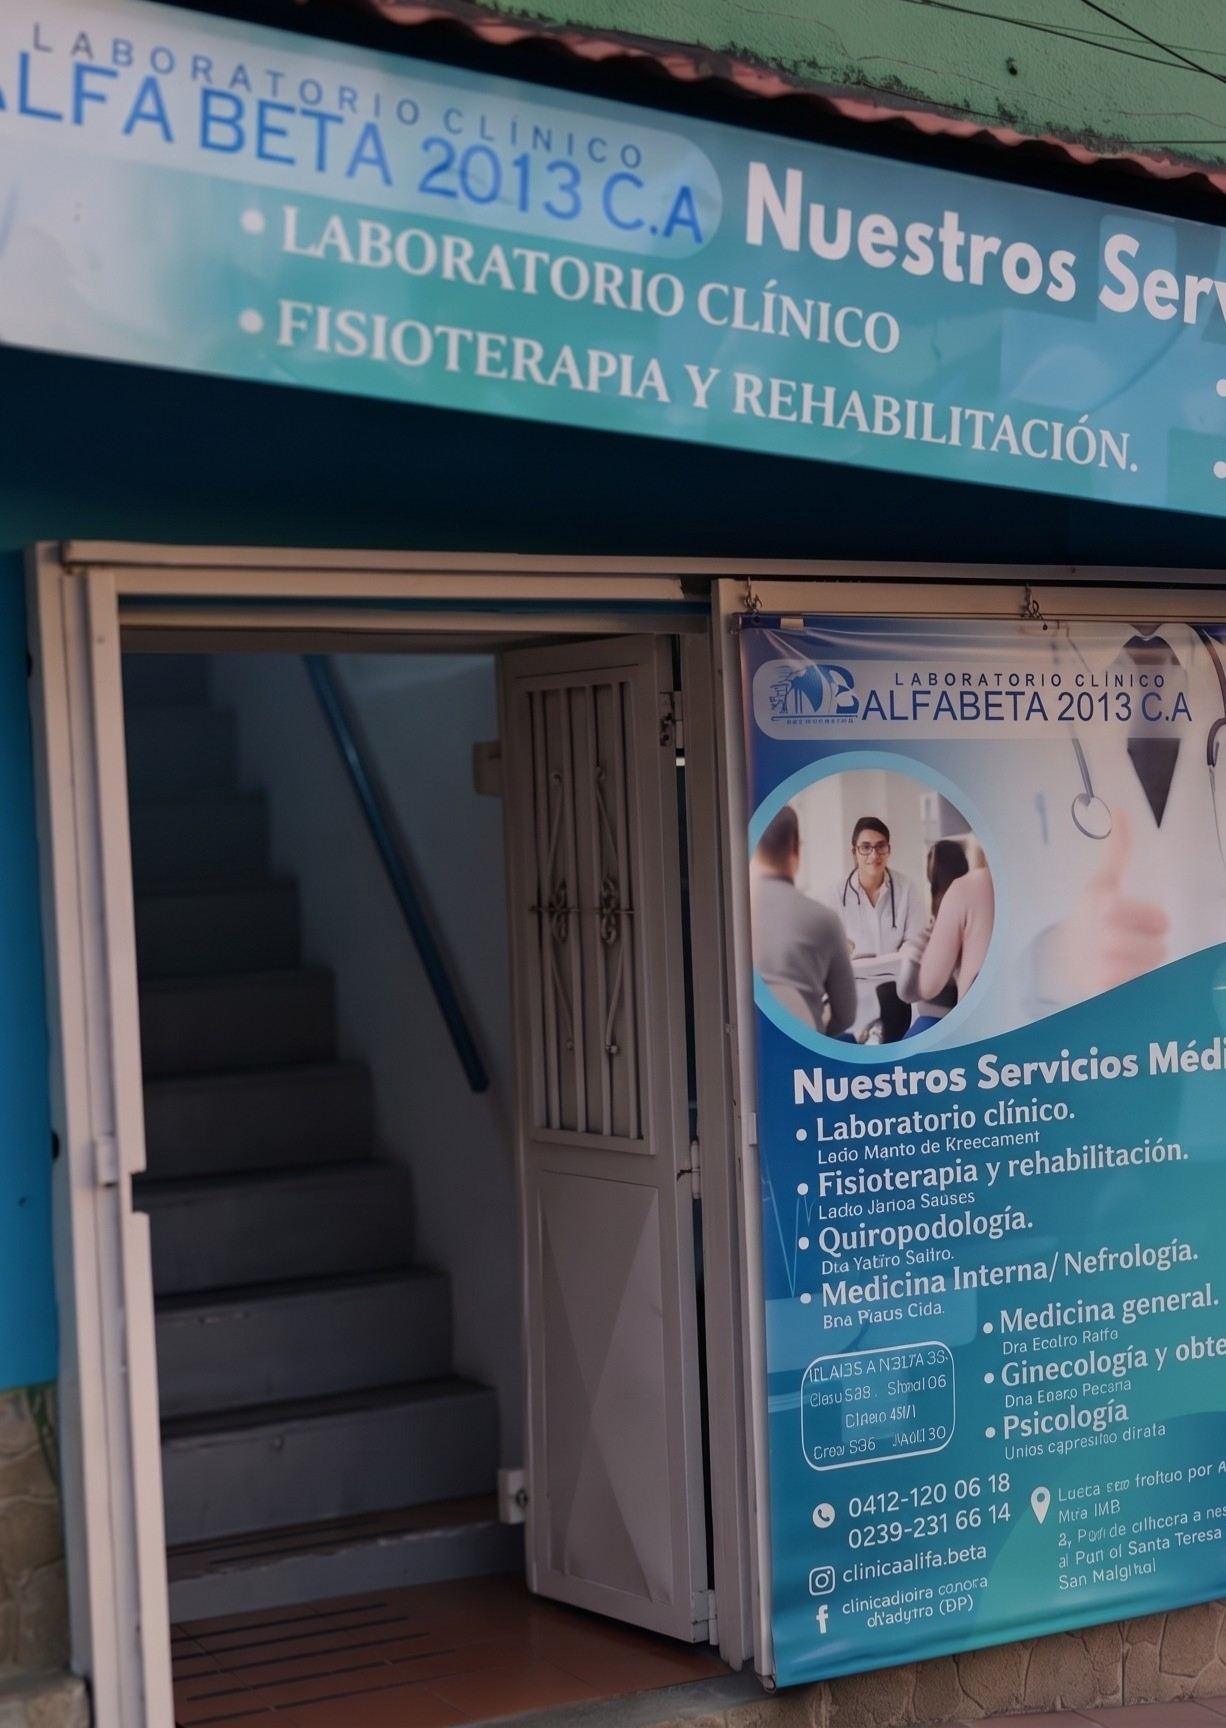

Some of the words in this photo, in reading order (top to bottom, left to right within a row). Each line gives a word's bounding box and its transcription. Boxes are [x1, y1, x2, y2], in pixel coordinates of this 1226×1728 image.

[32, 21, 421, 127] LABORATORIO
[442, 106, 643, 170] CLÍNICO
[0, 50, 175, 145] LFA
[417, 135, 583, 221] 2013
[601, 171, 704, 245] C.A
[745, 161, 1077, 304] Nuestros
[280, 205, 685, 317] LABORATORIO
[696, 278, 901, 355] CLÍNICO
[275, 298, 672, 404] FISIOTERAPIA
[683, 363, 720, 410] Y
[731, 372, 1139, 473] REHABILITACIÓN.
[894, 671, 1062, 687] LABORATORIO
[1074, 671, 1166, 688] CLÍNICO
[861, 689, 1050, 722] ALFABETA
[1057, 690, 1132, 723] 2013
[1141, 691, 1193, 722] C.A
[792, 1061, 967, 1105] Nuestros
[976, 1047, 1138, 1091] Servicios
[815, 1102, 976, 1142] Laboratorio
[983, 1098, 1076, 1128] clínico.
[818, 1157, 979, 1198] Fisioterapia
[986, 1160, 1001, 1188] y
[1008, 1138, 1190, 1178] rehabilitación.
[920, 1139, 941, 1155] de
[817, 1205, 1035, 1258] Quiropodología.
[821, 1270, 947, 1308] Medicina
[1064, 1237, 1200, 1277] Nefrología.
[999, 1298, 1116, 1335] Medicina
[1121, 1282, 1220, 1325] general.
[1001, 1344, 1149, 1388] Ginecología
[1154, 1346, 1169, 1372] y
[1003, 1398, 1130, 1440] Psicología
[847, 1482, 948, 1519] 0412-120
[953, 1476, 981, 1500] 06
[987, 1472, 1011, 1494] 18
[1187, 1463, 1214, 1483] por
[848, 1512, 948, 1550] 0239-231
[954, 1507, 982, 1531] 66
[987, 1502, 1012, 1525] 14
[1192, 1510, 1202, 1522] a
[842, 1543, 988, 1584] clinicaalifa.beta
[1127, 1535, 1171, 1556] Santa
[1174, 1526, 1223, 1546] Teresa
[1058, 1573, 1088, 1590] San
